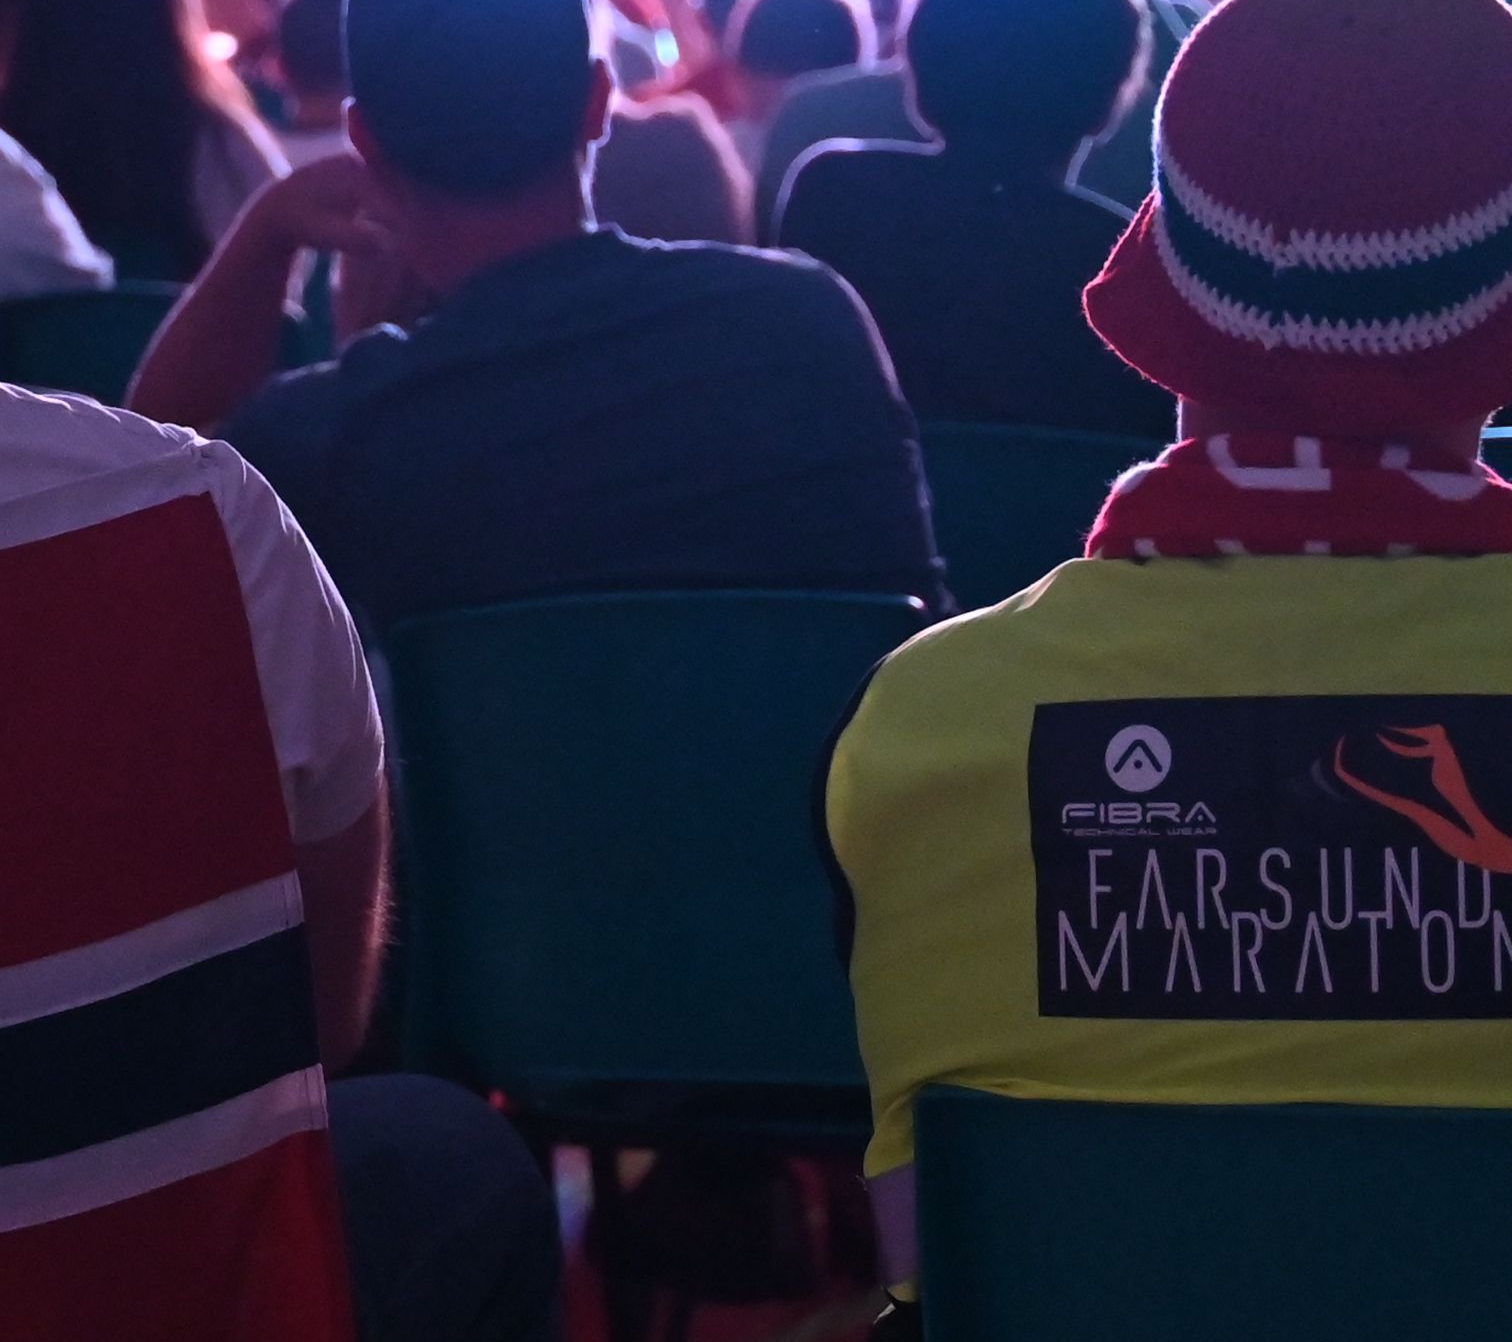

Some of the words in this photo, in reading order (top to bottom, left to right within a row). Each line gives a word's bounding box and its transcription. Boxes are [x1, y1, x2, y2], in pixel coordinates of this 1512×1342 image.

[1060, 801, 1217, 825] FIBRA
[1166, 825, 1218, 837] WEAR
[1087, 846, 1492, 932] FARSUND
